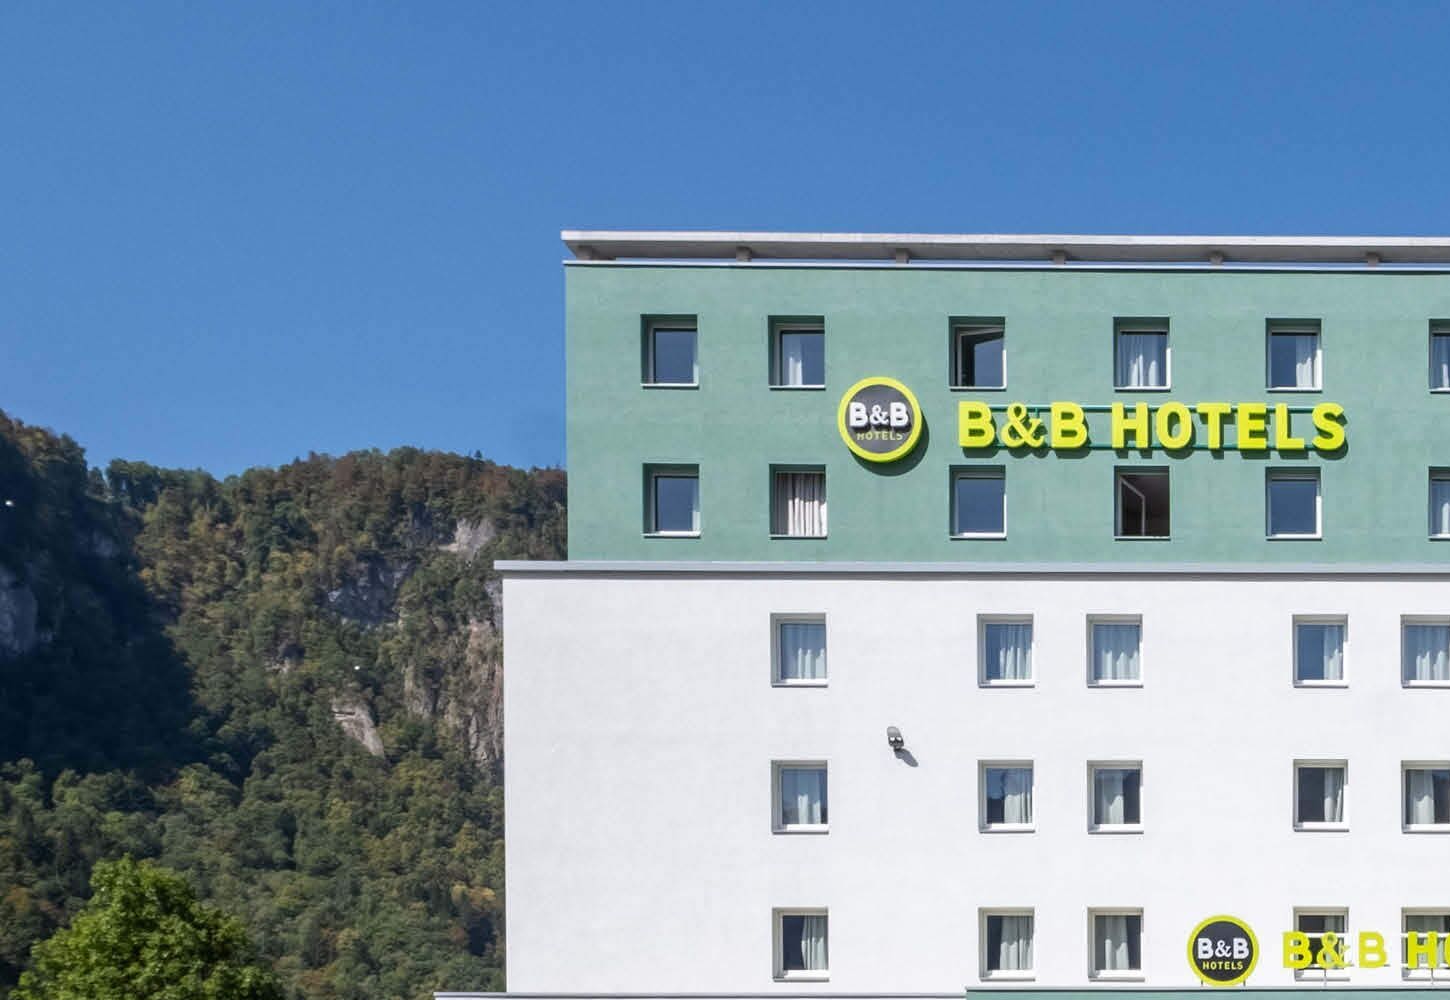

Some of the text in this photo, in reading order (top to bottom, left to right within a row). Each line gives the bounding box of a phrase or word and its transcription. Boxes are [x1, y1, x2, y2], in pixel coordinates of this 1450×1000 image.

[849, 402, 909, 427] B&B
[958, 401, 1346, 451] B&B HOTELS
[856, 430, 903, 441] HOTELS
[1198, 937, 1249, 960] B&B
[1282, 931, 1388, 969] B&B
[1202, 961, 1243, 970] HOTELS
